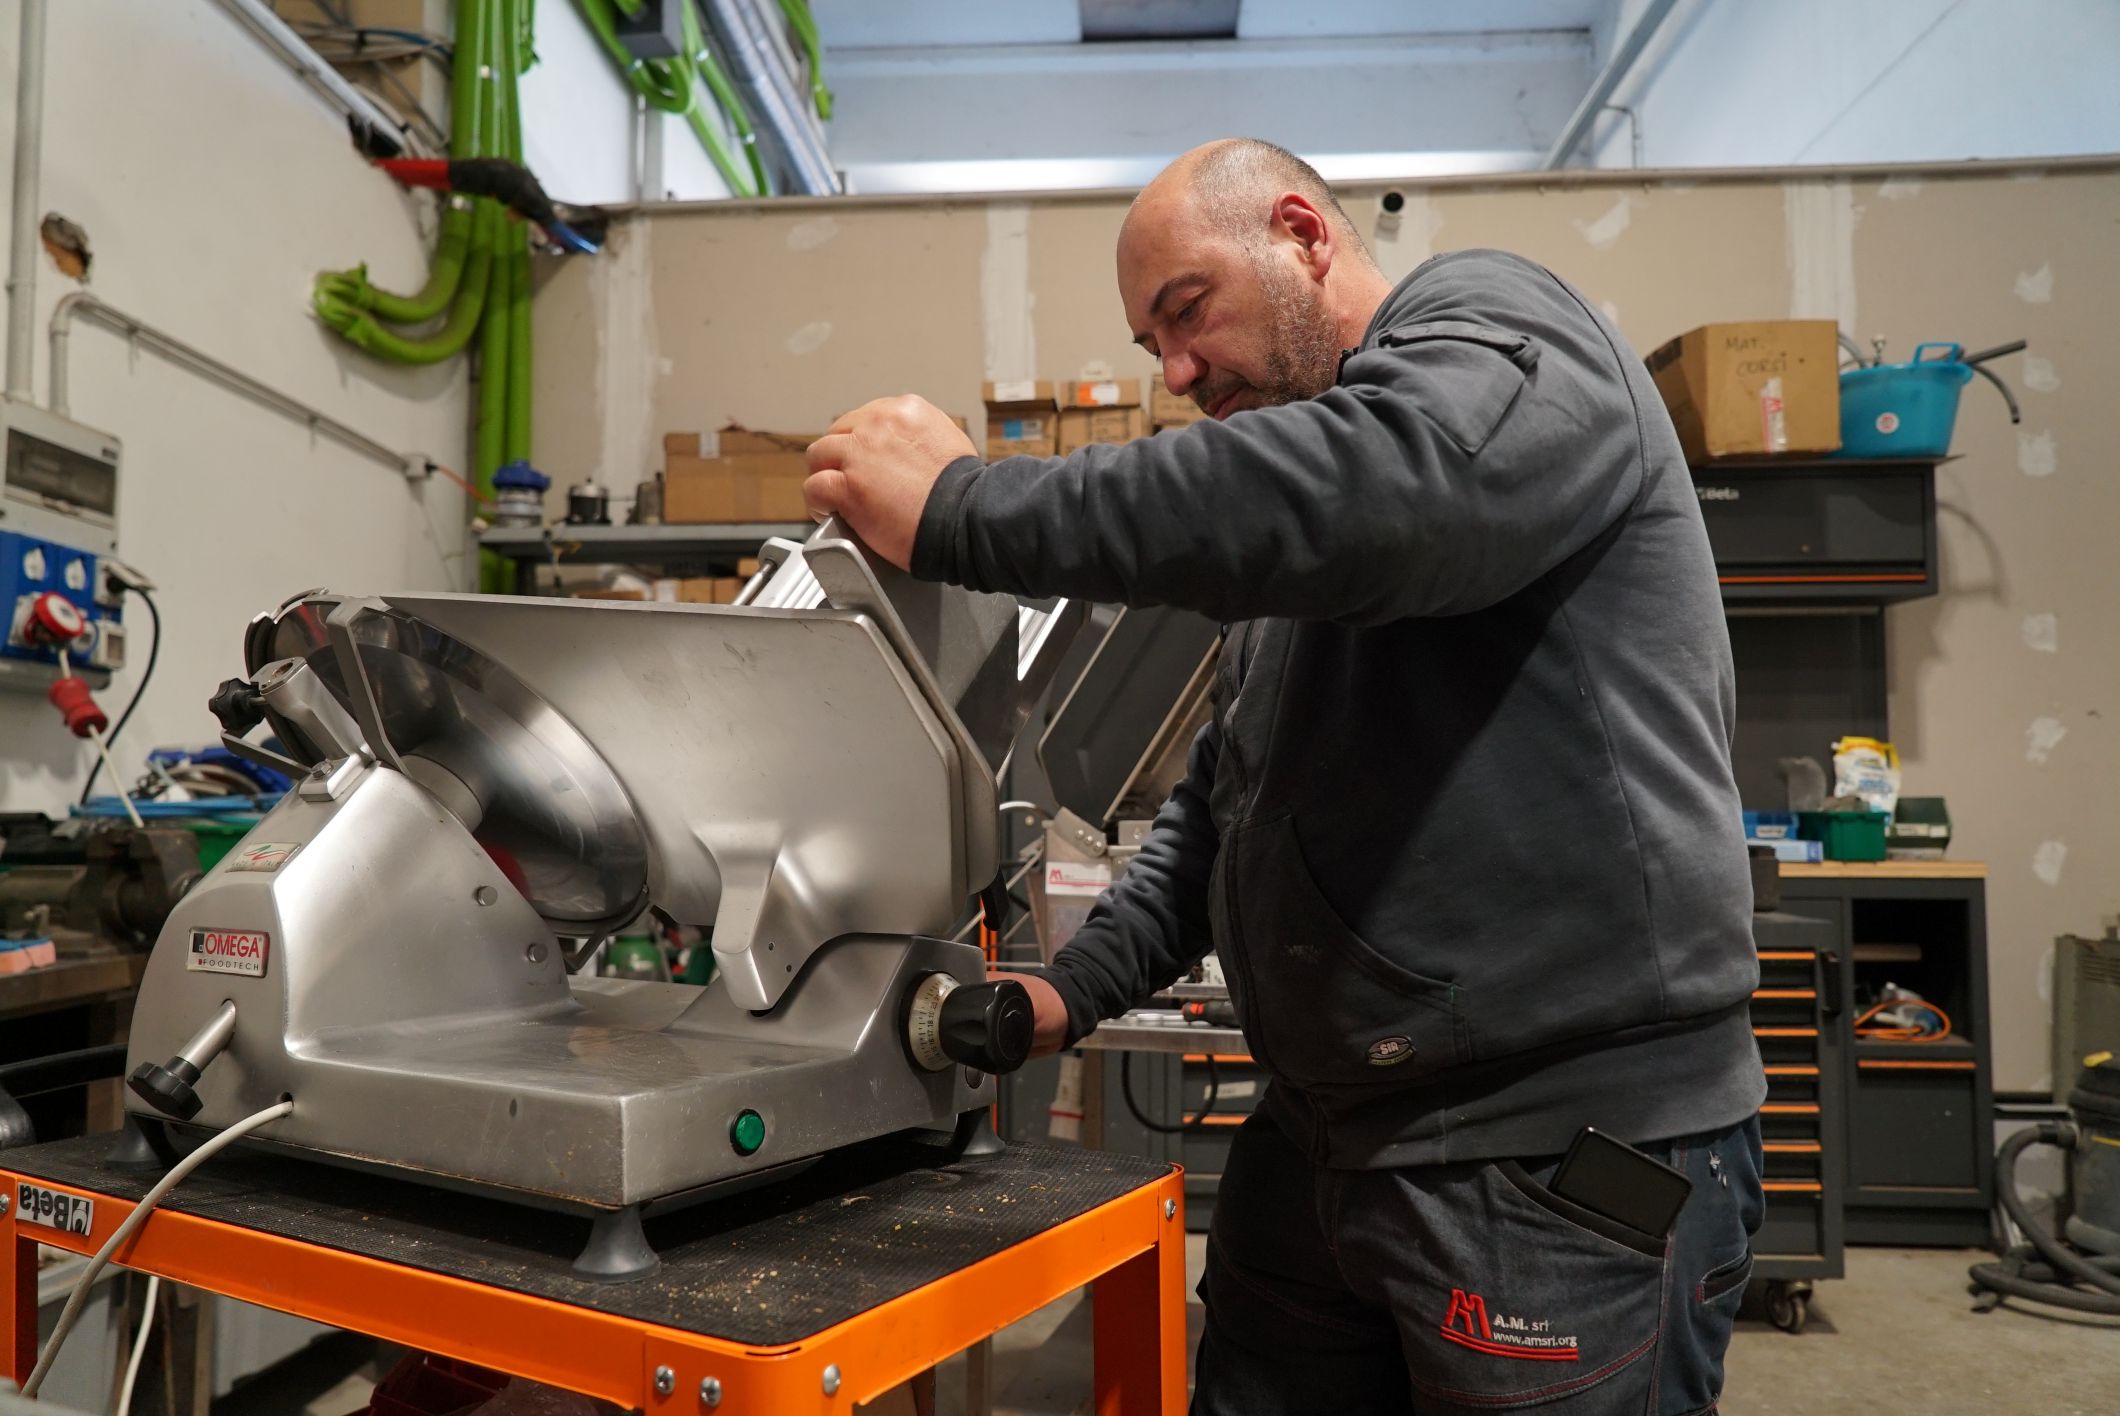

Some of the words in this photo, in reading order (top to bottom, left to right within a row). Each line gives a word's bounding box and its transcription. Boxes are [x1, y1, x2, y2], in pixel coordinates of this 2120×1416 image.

[205, 933, 260, 959] OMEGA
[203, 959, 260, 971] FOODTECH
[19, 1184, 70, 1231] Beta
[1493, 1314, 1529, 1331] A.M.
